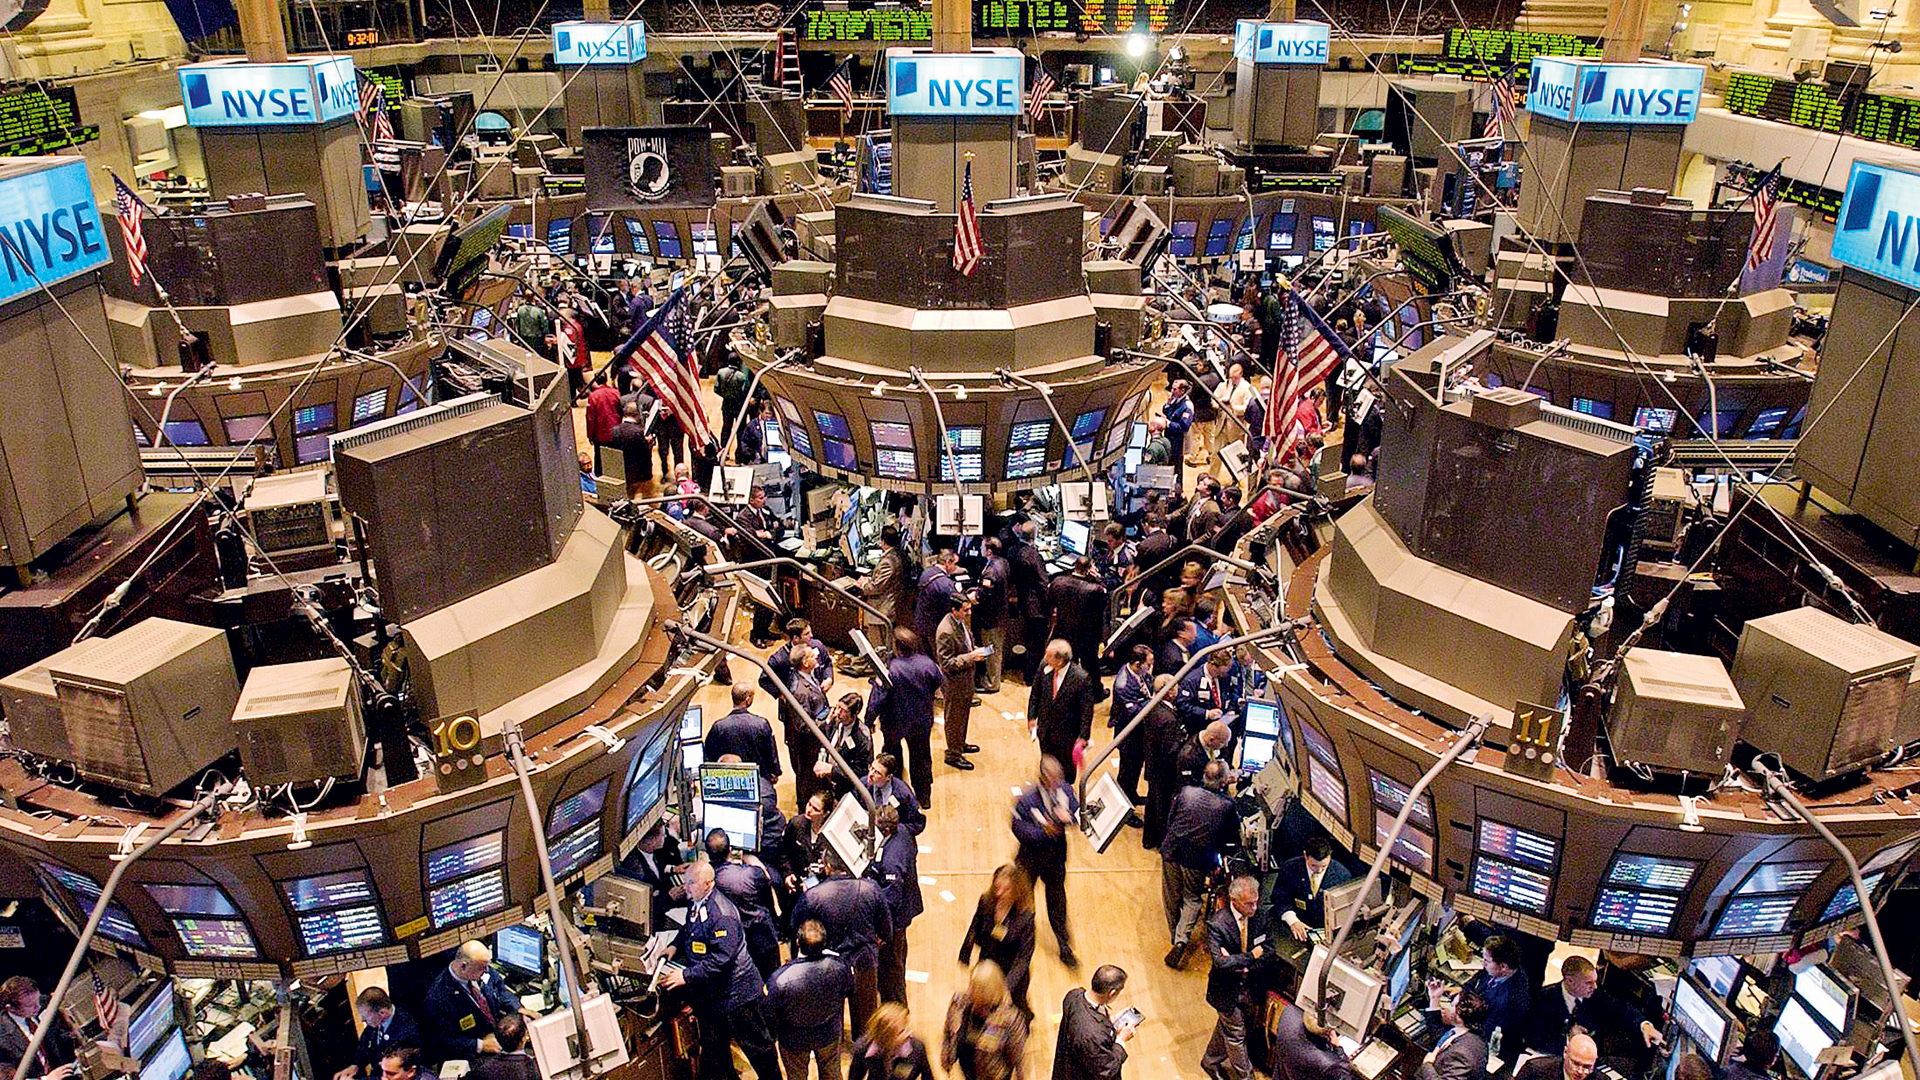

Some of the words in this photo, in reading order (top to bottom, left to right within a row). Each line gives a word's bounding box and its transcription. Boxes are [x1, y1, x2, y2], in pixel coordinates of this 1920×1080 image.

[347, 32, 378, 46] 9:32:01
[577, 40, 629, 57] NYSE
[1277, 40, 1327, 57] NYSE
[221, 88, 310, 118] NYSE
[330, 80, 359, 110] NYSE
[928, 79, 1014, 107] NYSE
[1539, 82, 1573, 112] NYSE
[1611, 88, 1694, 117] NYSE
[0, 201, 101, 282] NYSE
[433, 716, 480, 758] 10
[1516, 710, 1553, 747] 11
